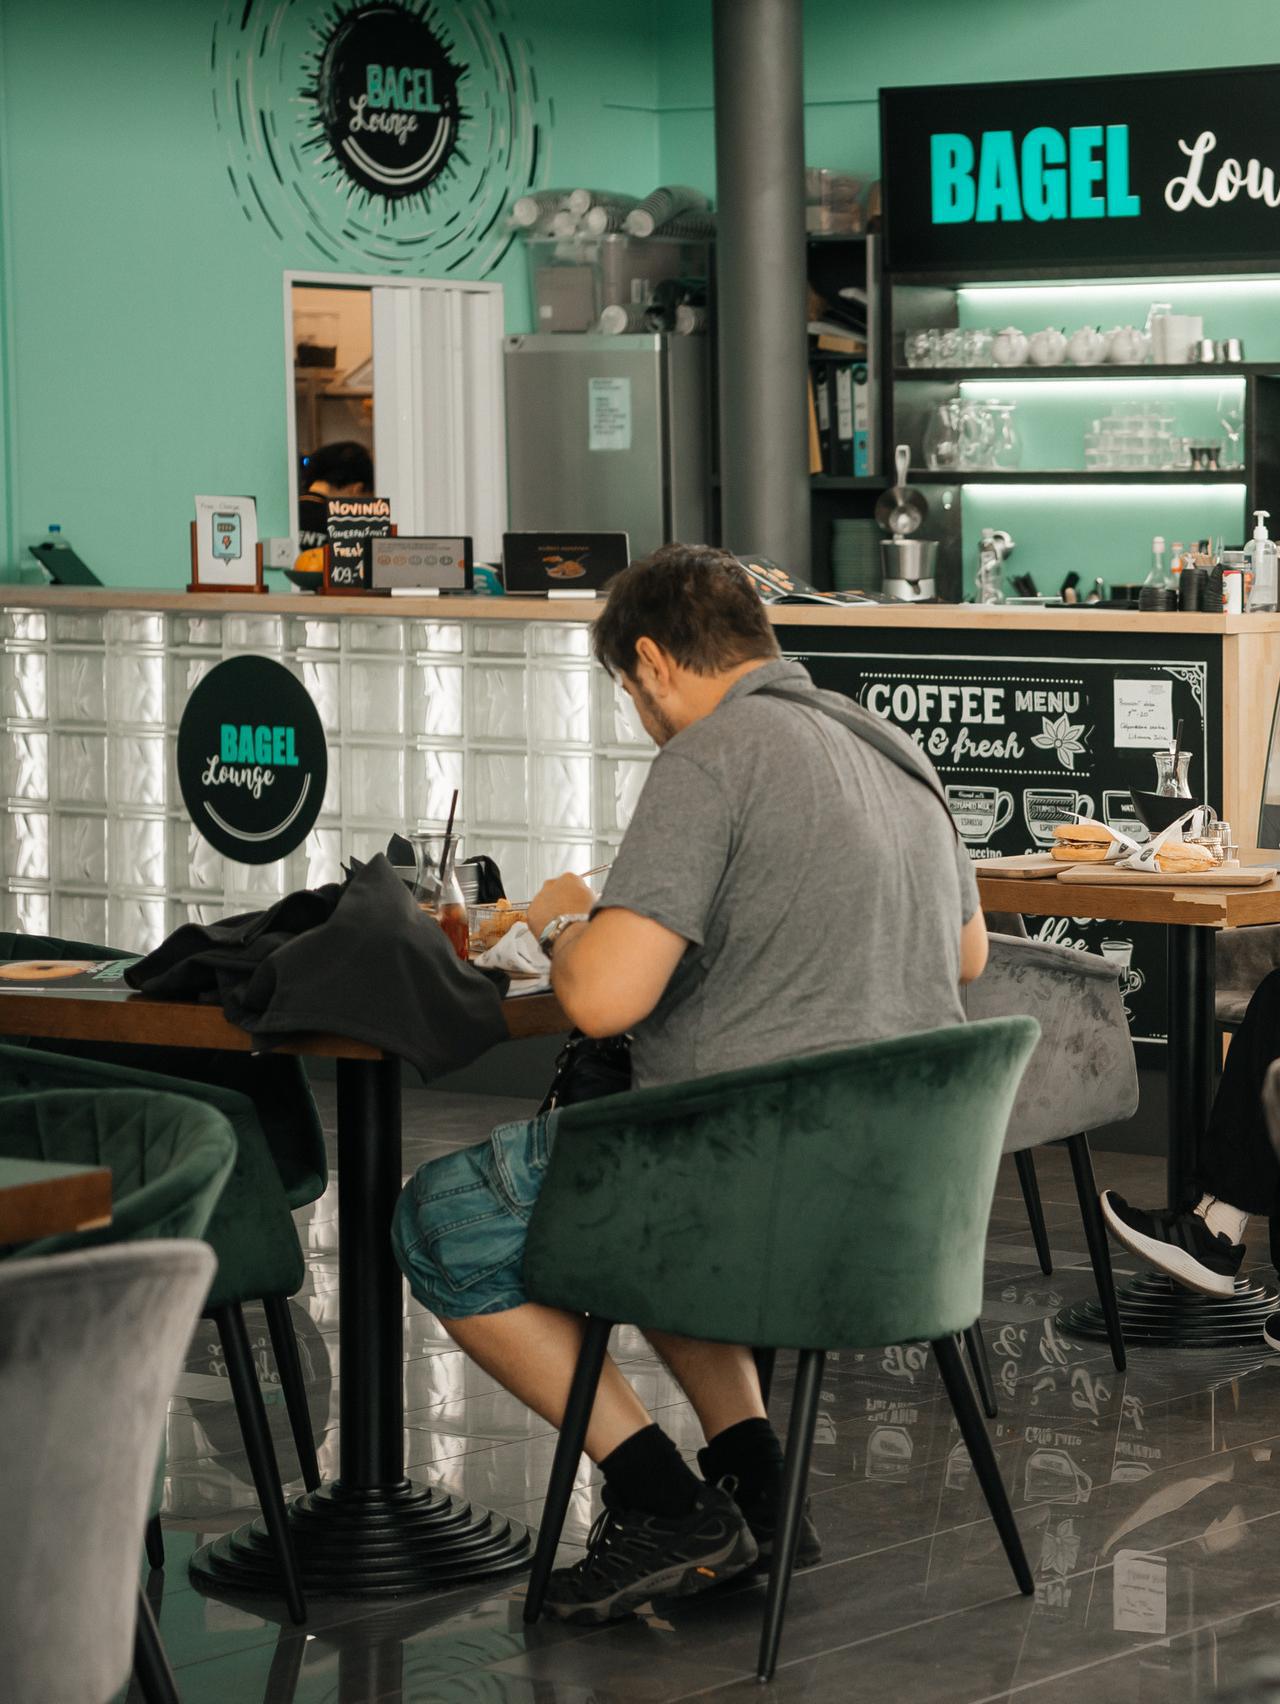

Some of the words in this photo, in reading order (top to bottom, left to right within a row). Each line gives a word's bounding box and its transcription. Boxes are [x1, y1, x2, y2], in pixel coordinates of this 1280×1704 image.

[366, 64, 441, 113] BAGEL
[349, 93, 418, 146] Lounge
[930, 124, 1141, 224] BAGEL
[328, 499, 390, 516] NOVINKA
[867, 683, 1005, 725] COFFEE
[1015, 690, 1080, 713] MENU
[220, 723, 300, 767] BAGEL
[928, 727, 949, 756] &
[951, 726, 1024, 764] fresh
[202, 754, 275, 799] Lounge
[968, 847, 1002, 859] uccino
